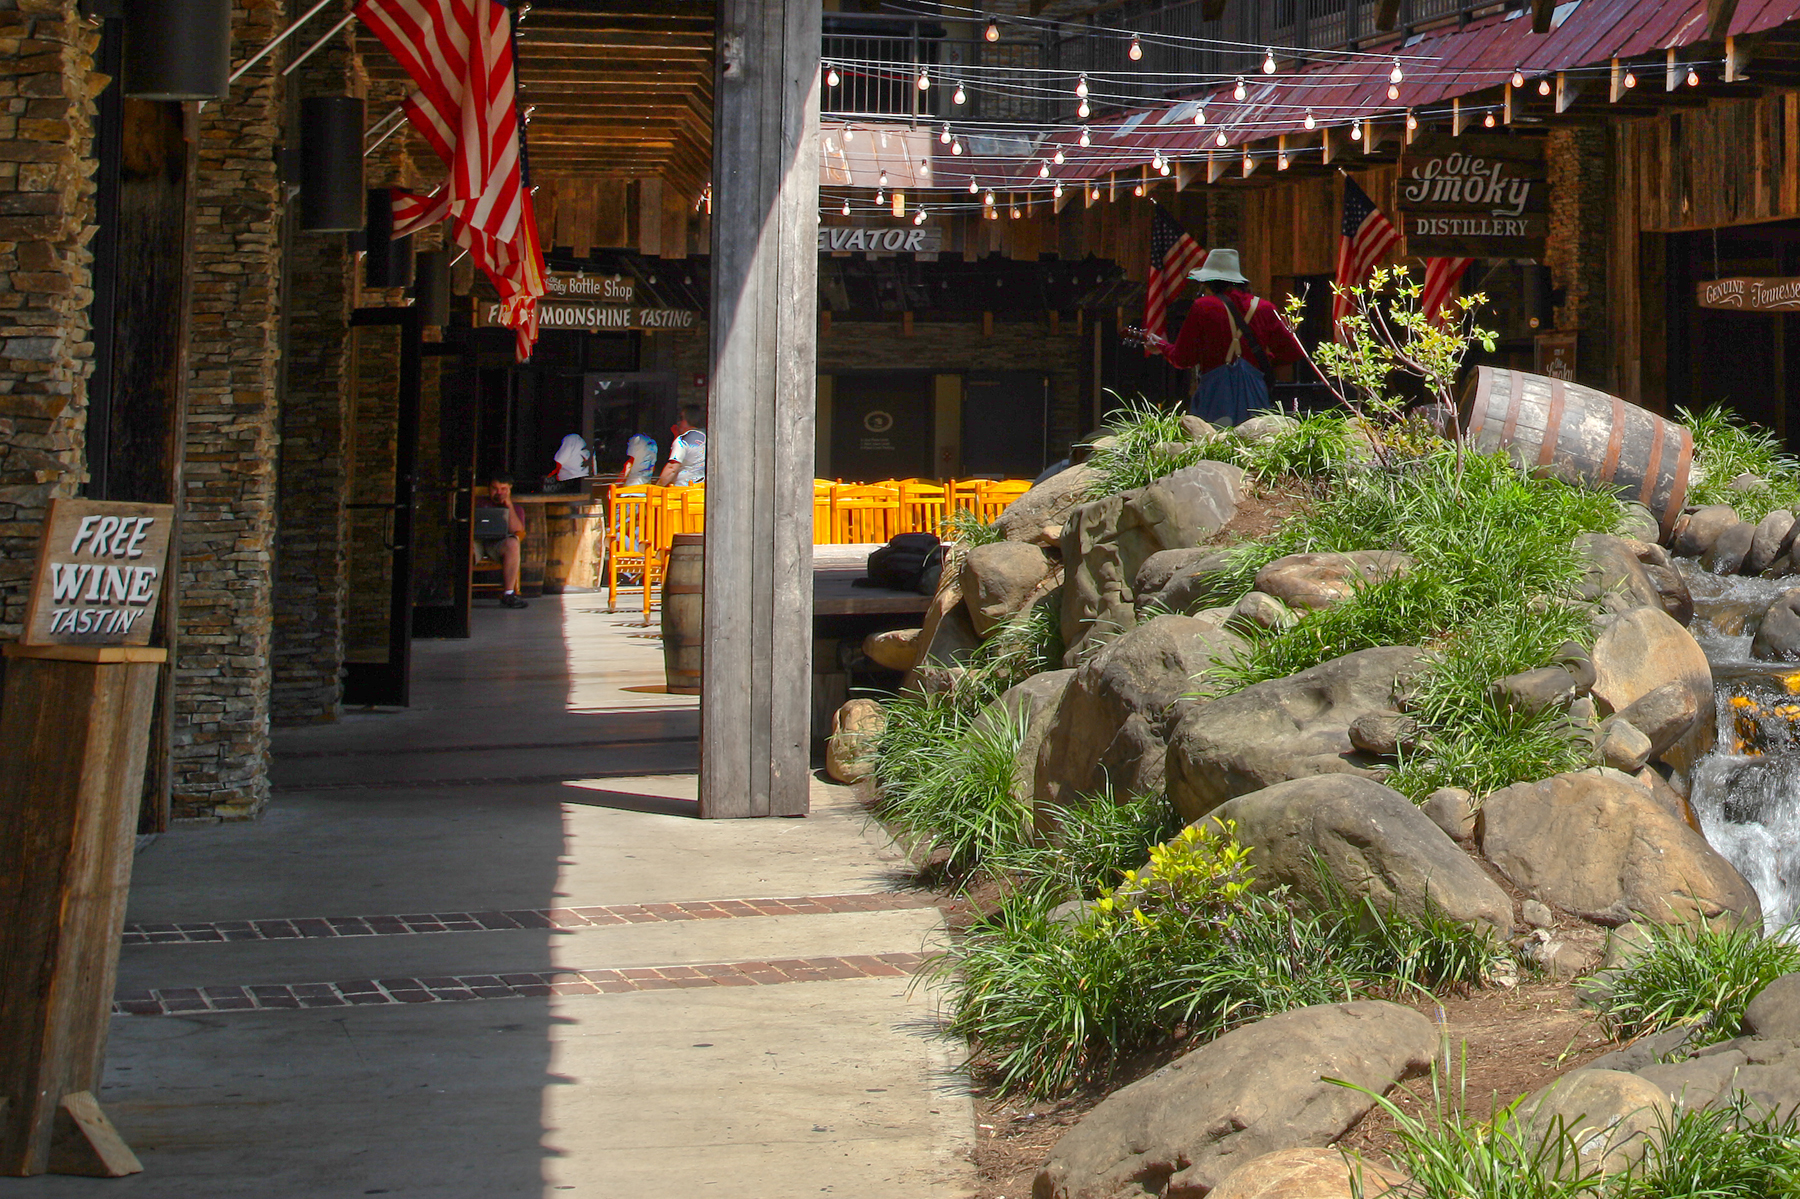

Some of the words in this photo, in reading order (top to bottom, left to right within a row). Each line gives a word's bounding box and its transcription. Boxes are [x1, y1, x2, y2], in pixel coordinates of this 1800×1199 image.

[1446, 152, 1491, 176] Ole
[1405, 158, 1530, 217] Smoky
[1416, 218, 1529, 236] DISTILLERY
[569, 277, 600, 294] Bottle
[604, 279, 633, 300] Shop
[1706, 279, 1745, 304] GENUINE
[539, 306, 631, 327] MOONSHINE
[639, 308, 692, 328] TASTING
[71, 515, 154, 558] FREE
[50, 563, 157, 604] WINE
[49, 608, 145, 635] TASTIN'
